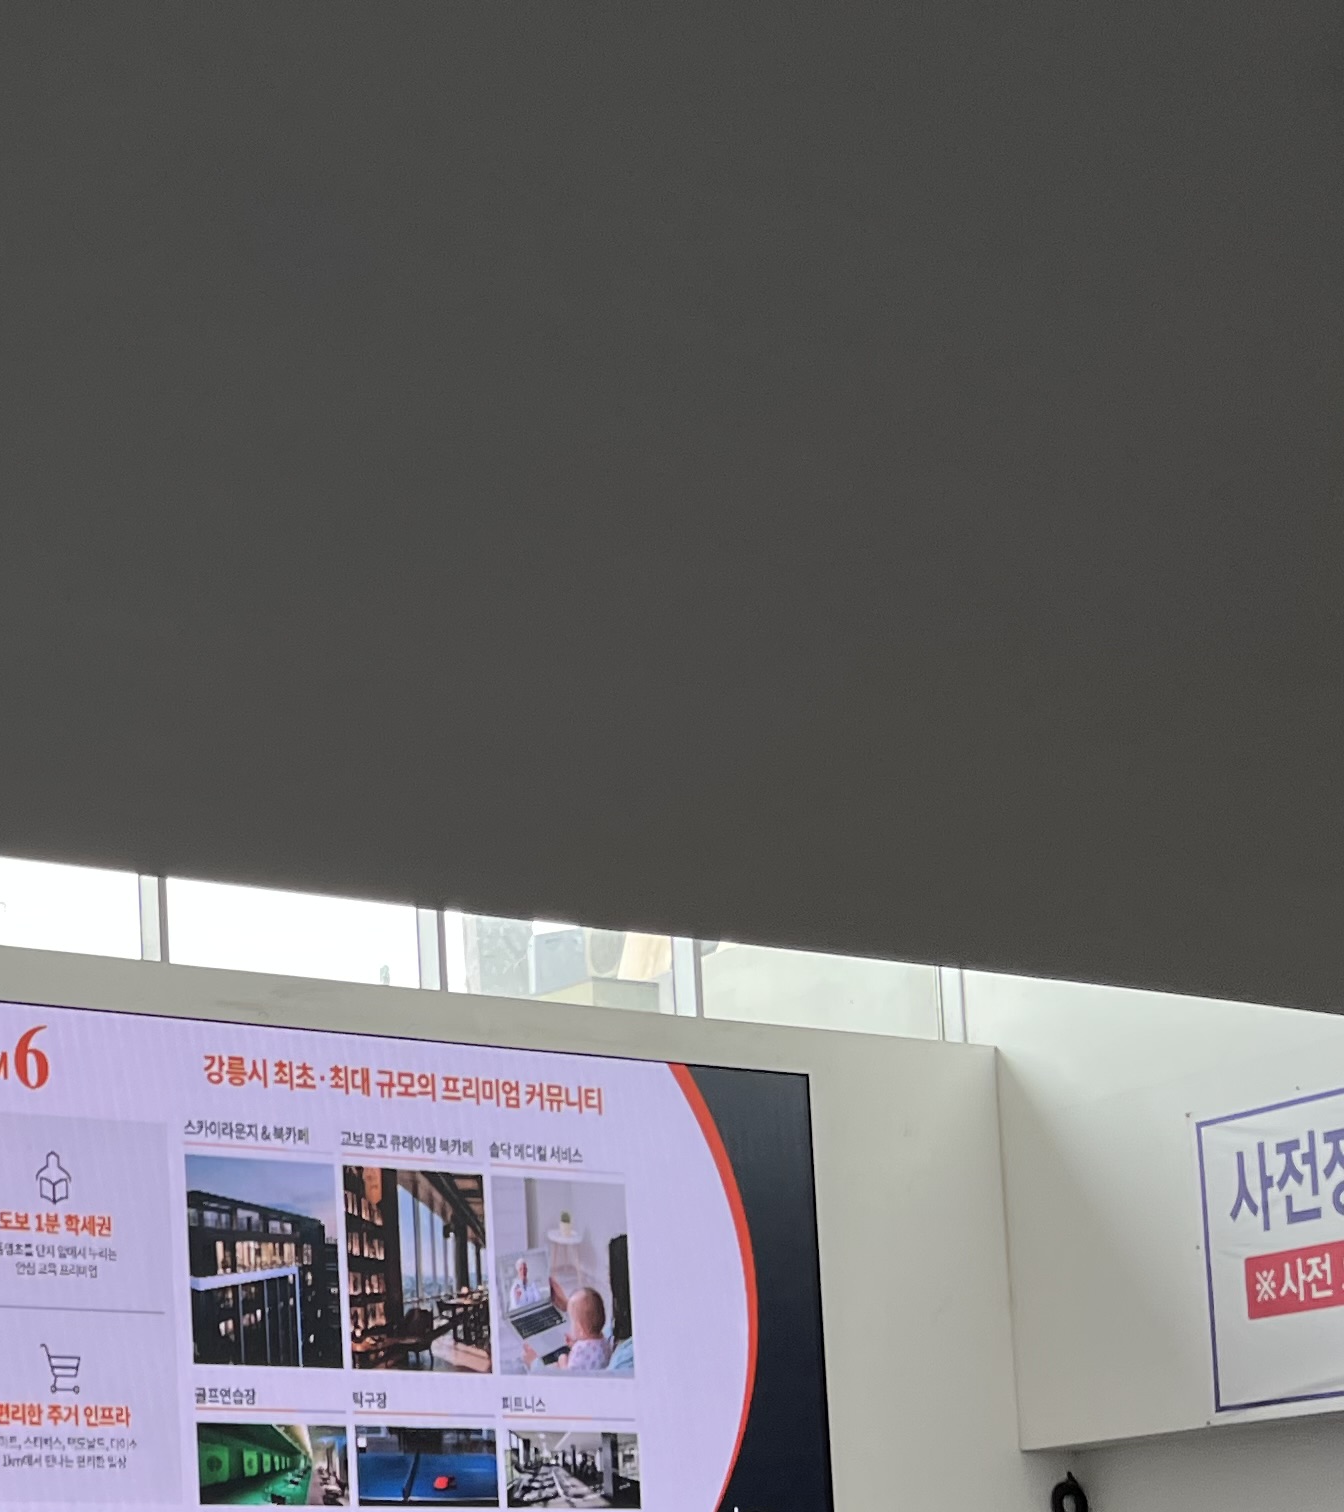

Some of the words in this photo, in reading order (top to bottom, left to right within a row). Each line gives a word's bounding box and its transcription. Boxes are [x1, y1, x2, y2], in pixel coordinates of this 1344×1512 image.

[203, 1054, 269, 1089] 강릉시
[377, 1068, 438, 1102] 규모의
[441, 1073, 521, 1109] 프리미엄
[525, 1080, 605, 1116] 커뮤니티
[550, 1145, 583, 1165] 서비스
[35, 1213, 61, 1234] 1분
[64, 1213, 112, 1237] 학세권
[47, 1403, 79, 1427] 주거
[84, 1405, 131, 1428] 인프라
